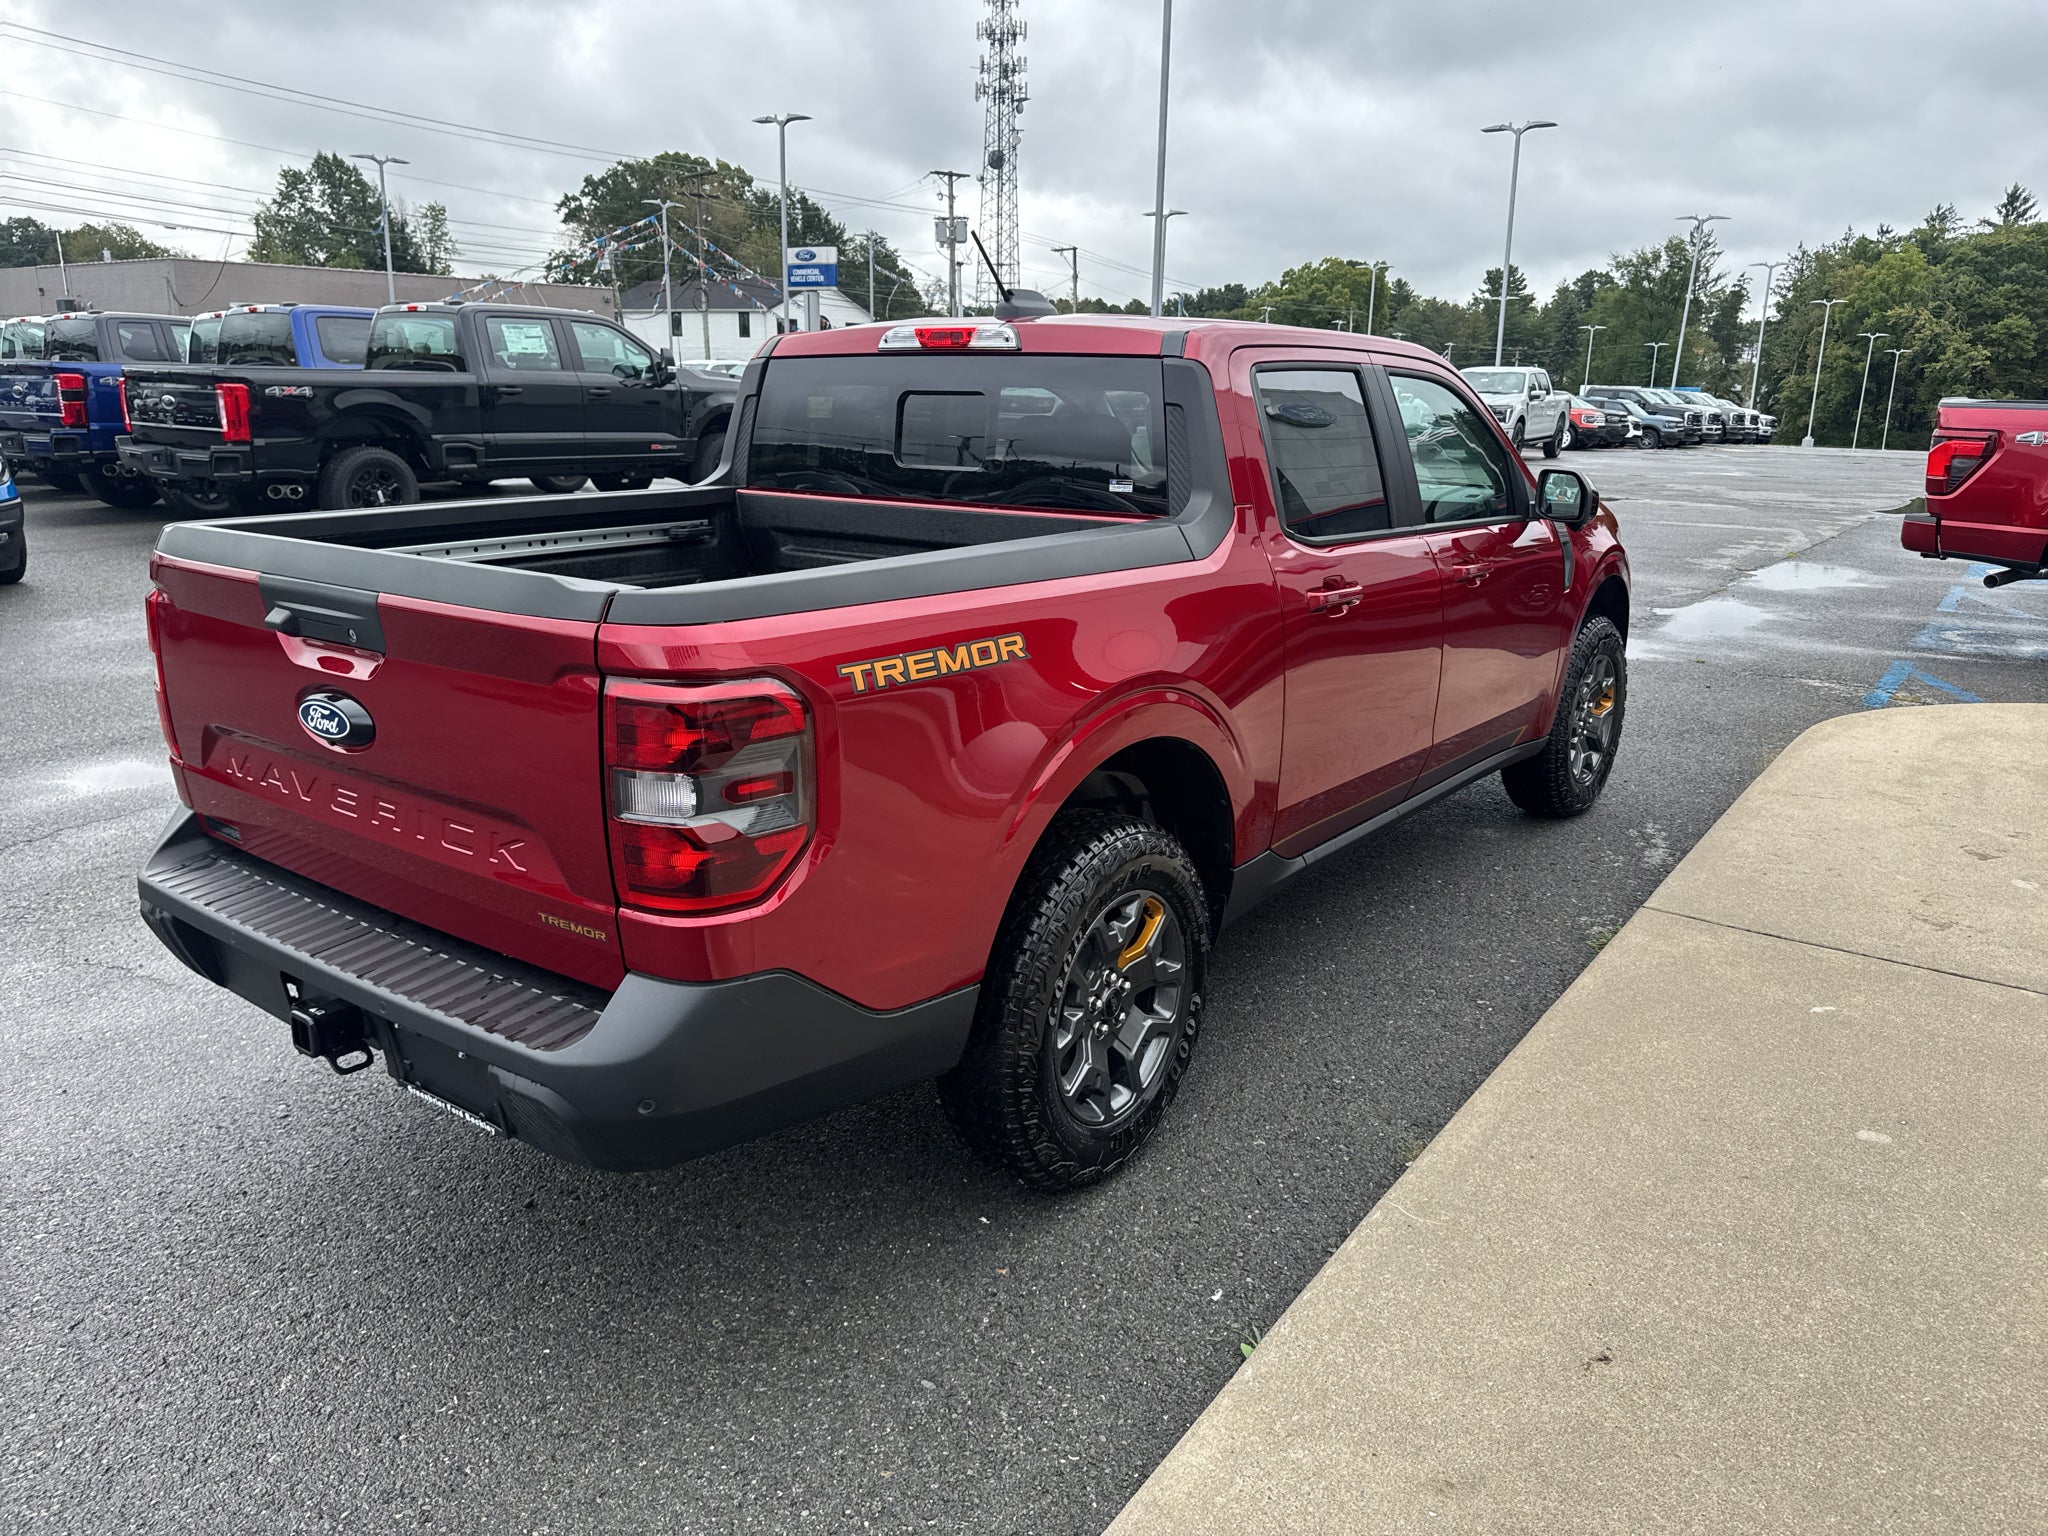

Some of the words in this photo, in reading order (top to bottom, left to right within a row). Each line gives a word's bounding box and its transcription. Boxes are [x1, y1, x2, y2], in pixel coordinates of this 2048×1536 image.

[838, 632, 1030, 694] TREMOR
[307, 704, 340, 735] Ford
[226, 754, 528, 873] MAVERICK
[537, 911, 608, 942] TREMOR
[446, 1103, 464, 1118] Ford
